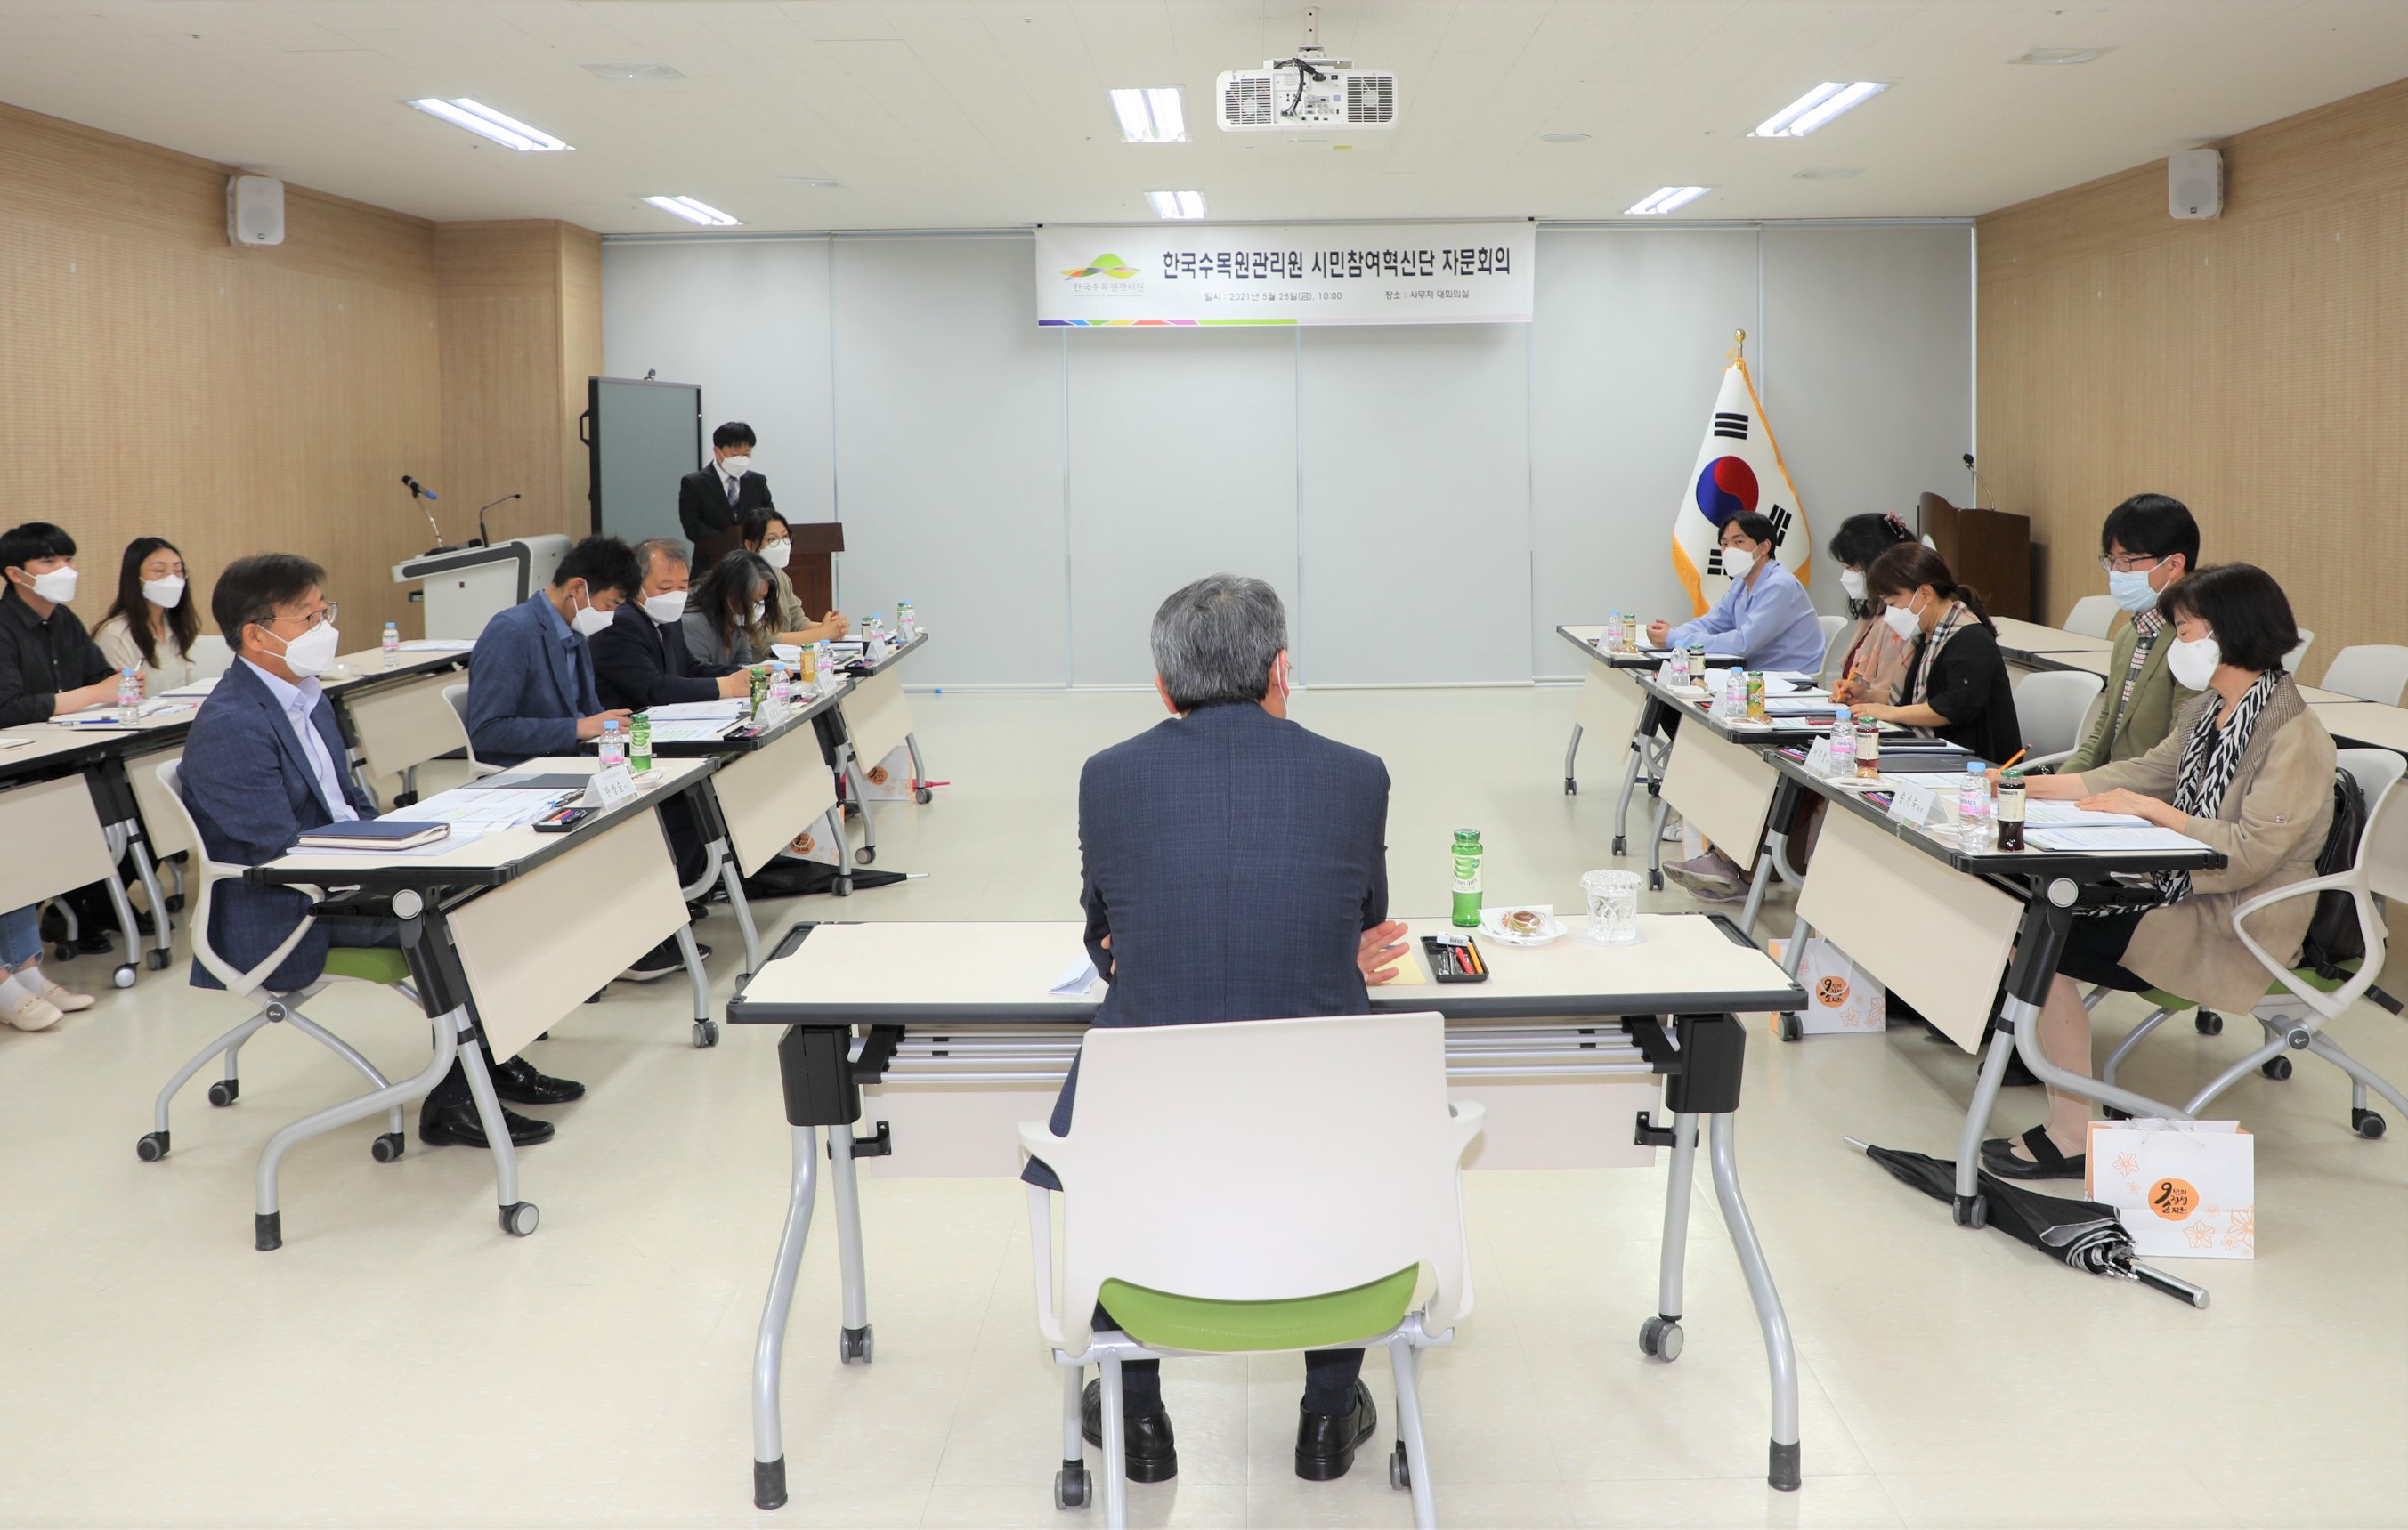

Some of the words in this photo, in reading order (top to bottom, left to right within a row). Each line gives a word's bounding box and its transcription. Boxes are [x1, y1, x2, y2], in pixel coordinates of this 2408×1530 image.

[1163, 250, 1303, 279] 한국수목원관리원
[1311, 249, 1435, 279] 시민참여혁신단
[1442, 247, 1511, 276] 자문회의
[1074, 282, 1145, 292] 한국수목원관리원
[1204, 292, 1221, 302] 일시
[1229, 292, 1260, 302] 2021년
[1262, 292, 1277, 301] 5월
[1318, 291, 1342, 301] 10:00
[1384, 290, 1401, 300] 장소
[1409, 290, 1434, 299] 사무처
[1437, 289, 1470, 299] 대회의실
